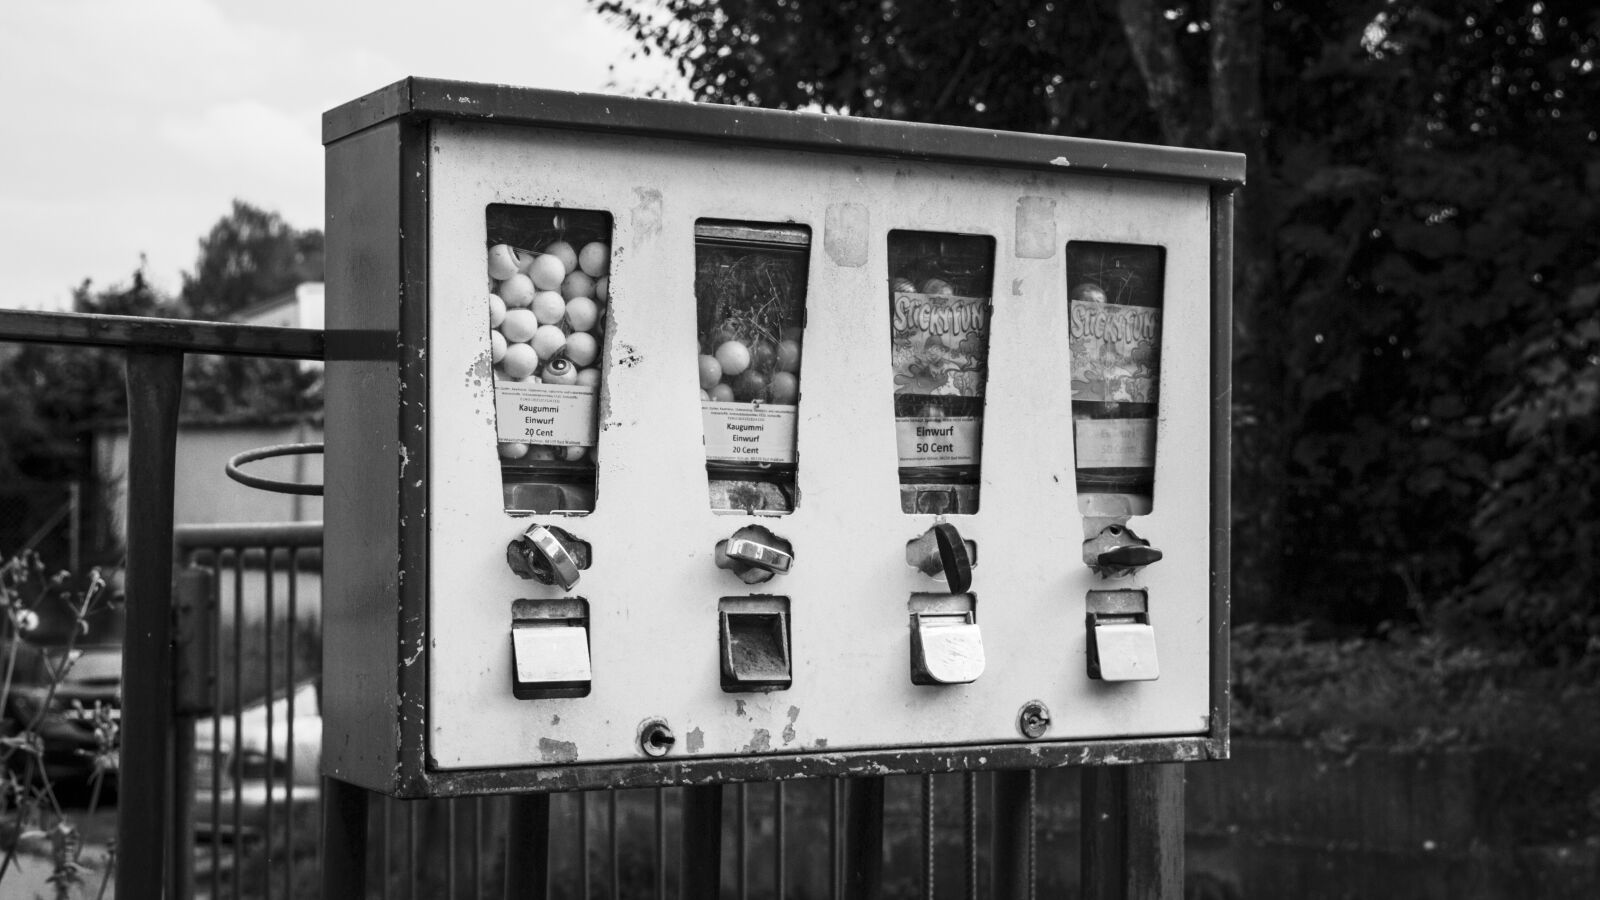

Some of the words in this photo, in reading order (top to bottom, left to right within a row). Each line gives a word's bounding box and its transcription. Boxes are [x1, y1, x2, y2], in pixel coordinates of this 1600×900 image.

[519, 404, 559, 413] Kaugummi
[525, 416, 554, 425] Einwurf
[525, 428, 534, 436] 20
[536, 428, 553, 436] Cent
[727, 423, 764, 432] Kaugummi
[916, 426, 954, 436] Einwurf
[732, 434, 760, 442] Einwurf
[916, 443, 928, 452] 50
[931, 443, 953, 452] Cent
